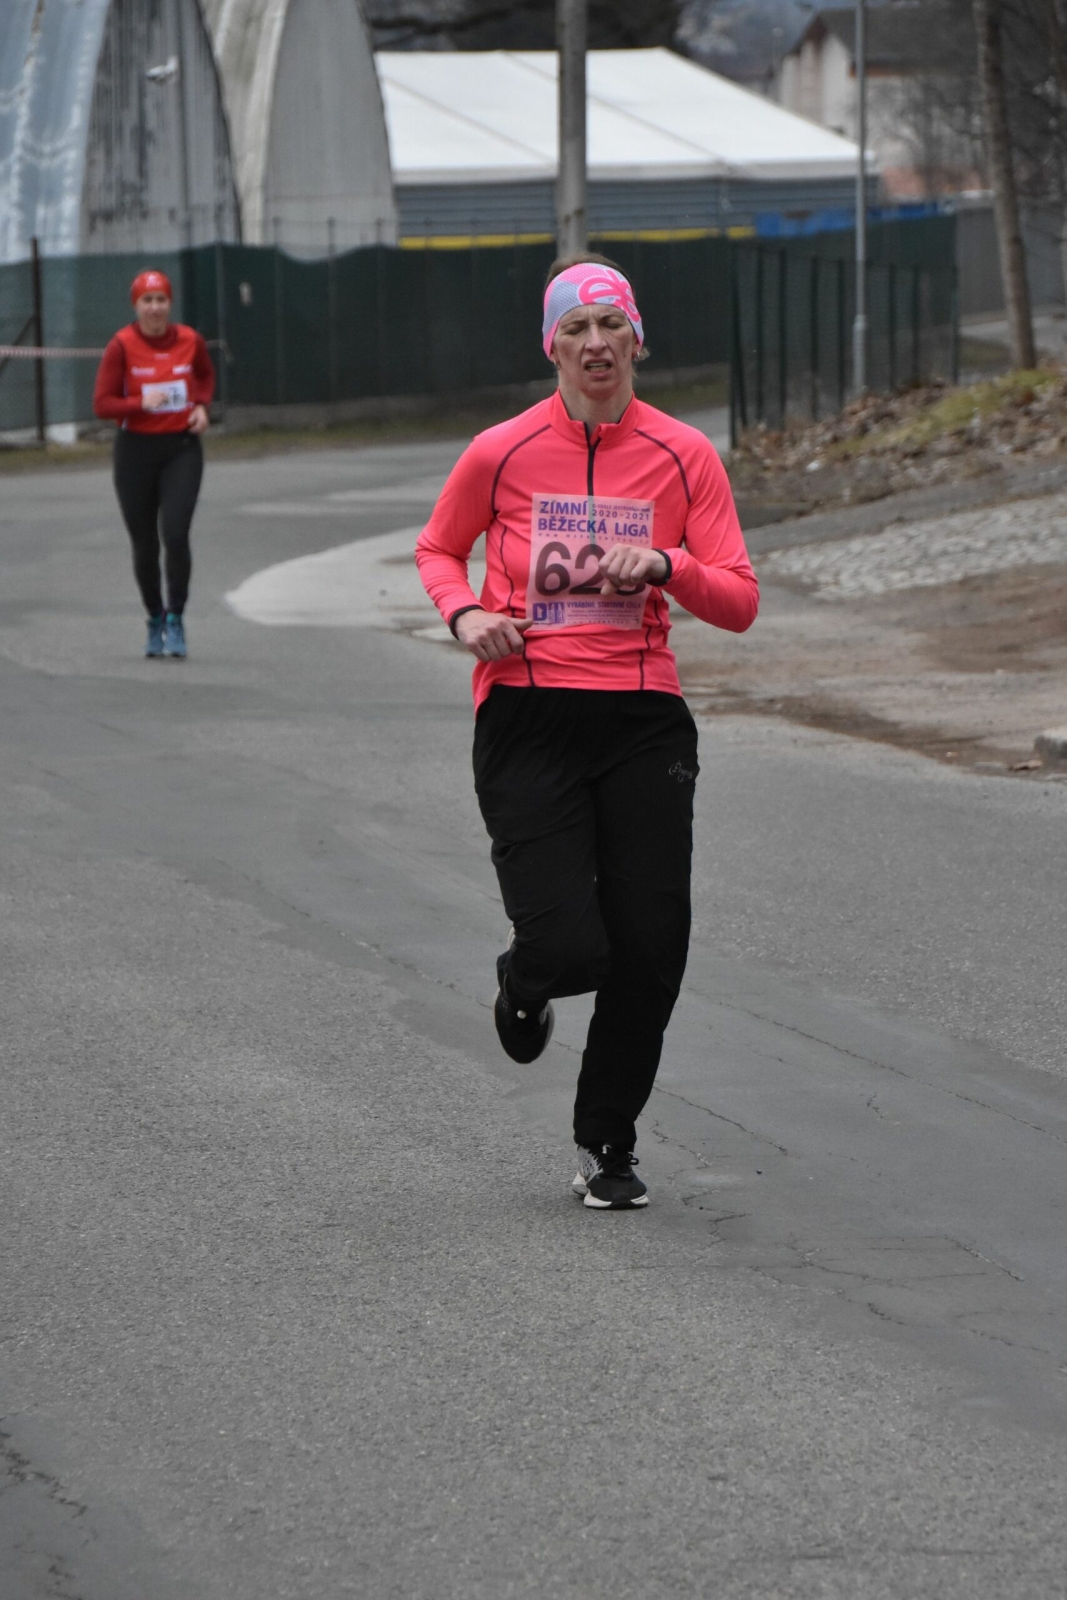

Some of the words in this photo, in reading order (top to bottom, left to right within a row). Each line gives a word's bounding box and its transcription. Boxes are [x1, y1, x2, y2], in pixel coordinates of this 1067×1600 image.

[538, 516, 607, 534] BĚŽECKÁ
[614, 522, 649, 538] LIGA
[535, 541, 646, 596] 62
